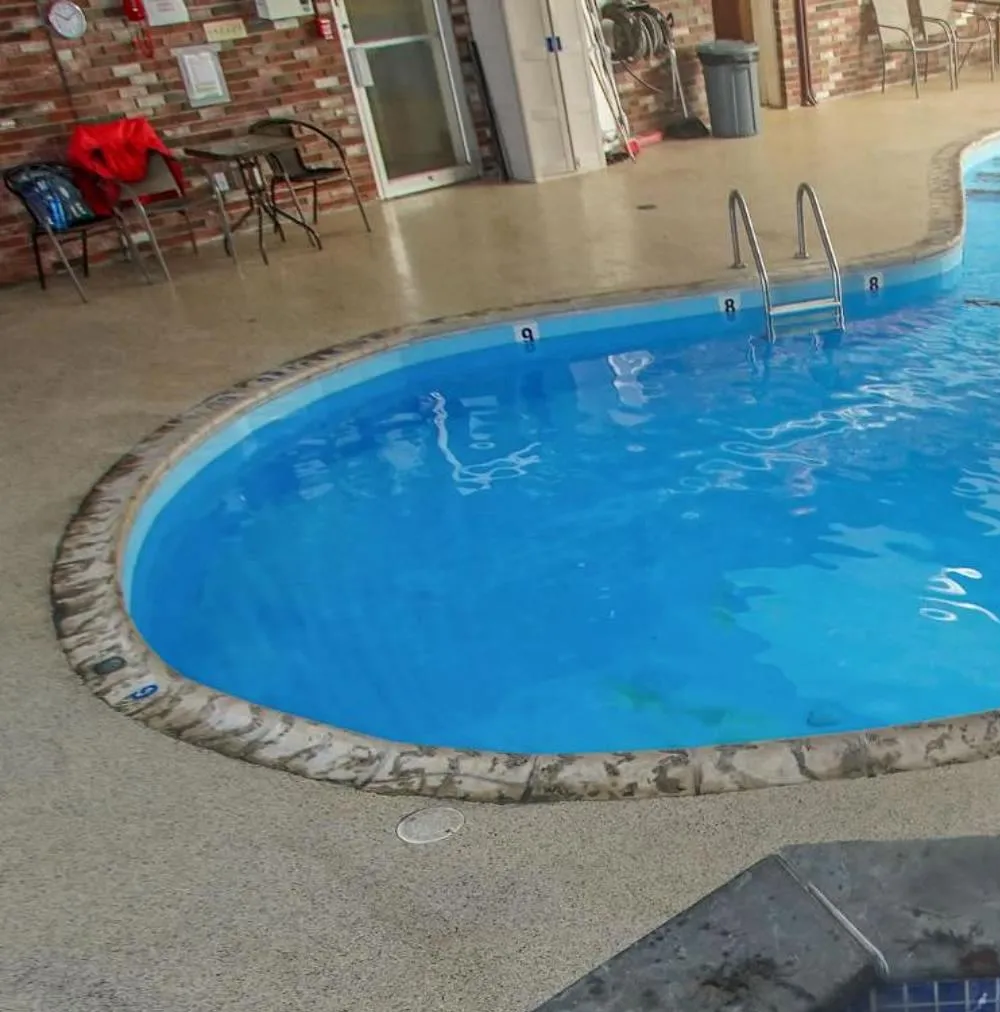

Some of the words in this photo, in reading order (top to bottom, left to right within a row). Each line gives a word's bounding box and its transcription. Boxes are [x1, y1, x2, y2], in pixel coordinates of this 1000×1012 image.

[869, 276, 879, 291] 8
[724, 298, 736, 313] 8
[521, 327, 535, 343] 9
